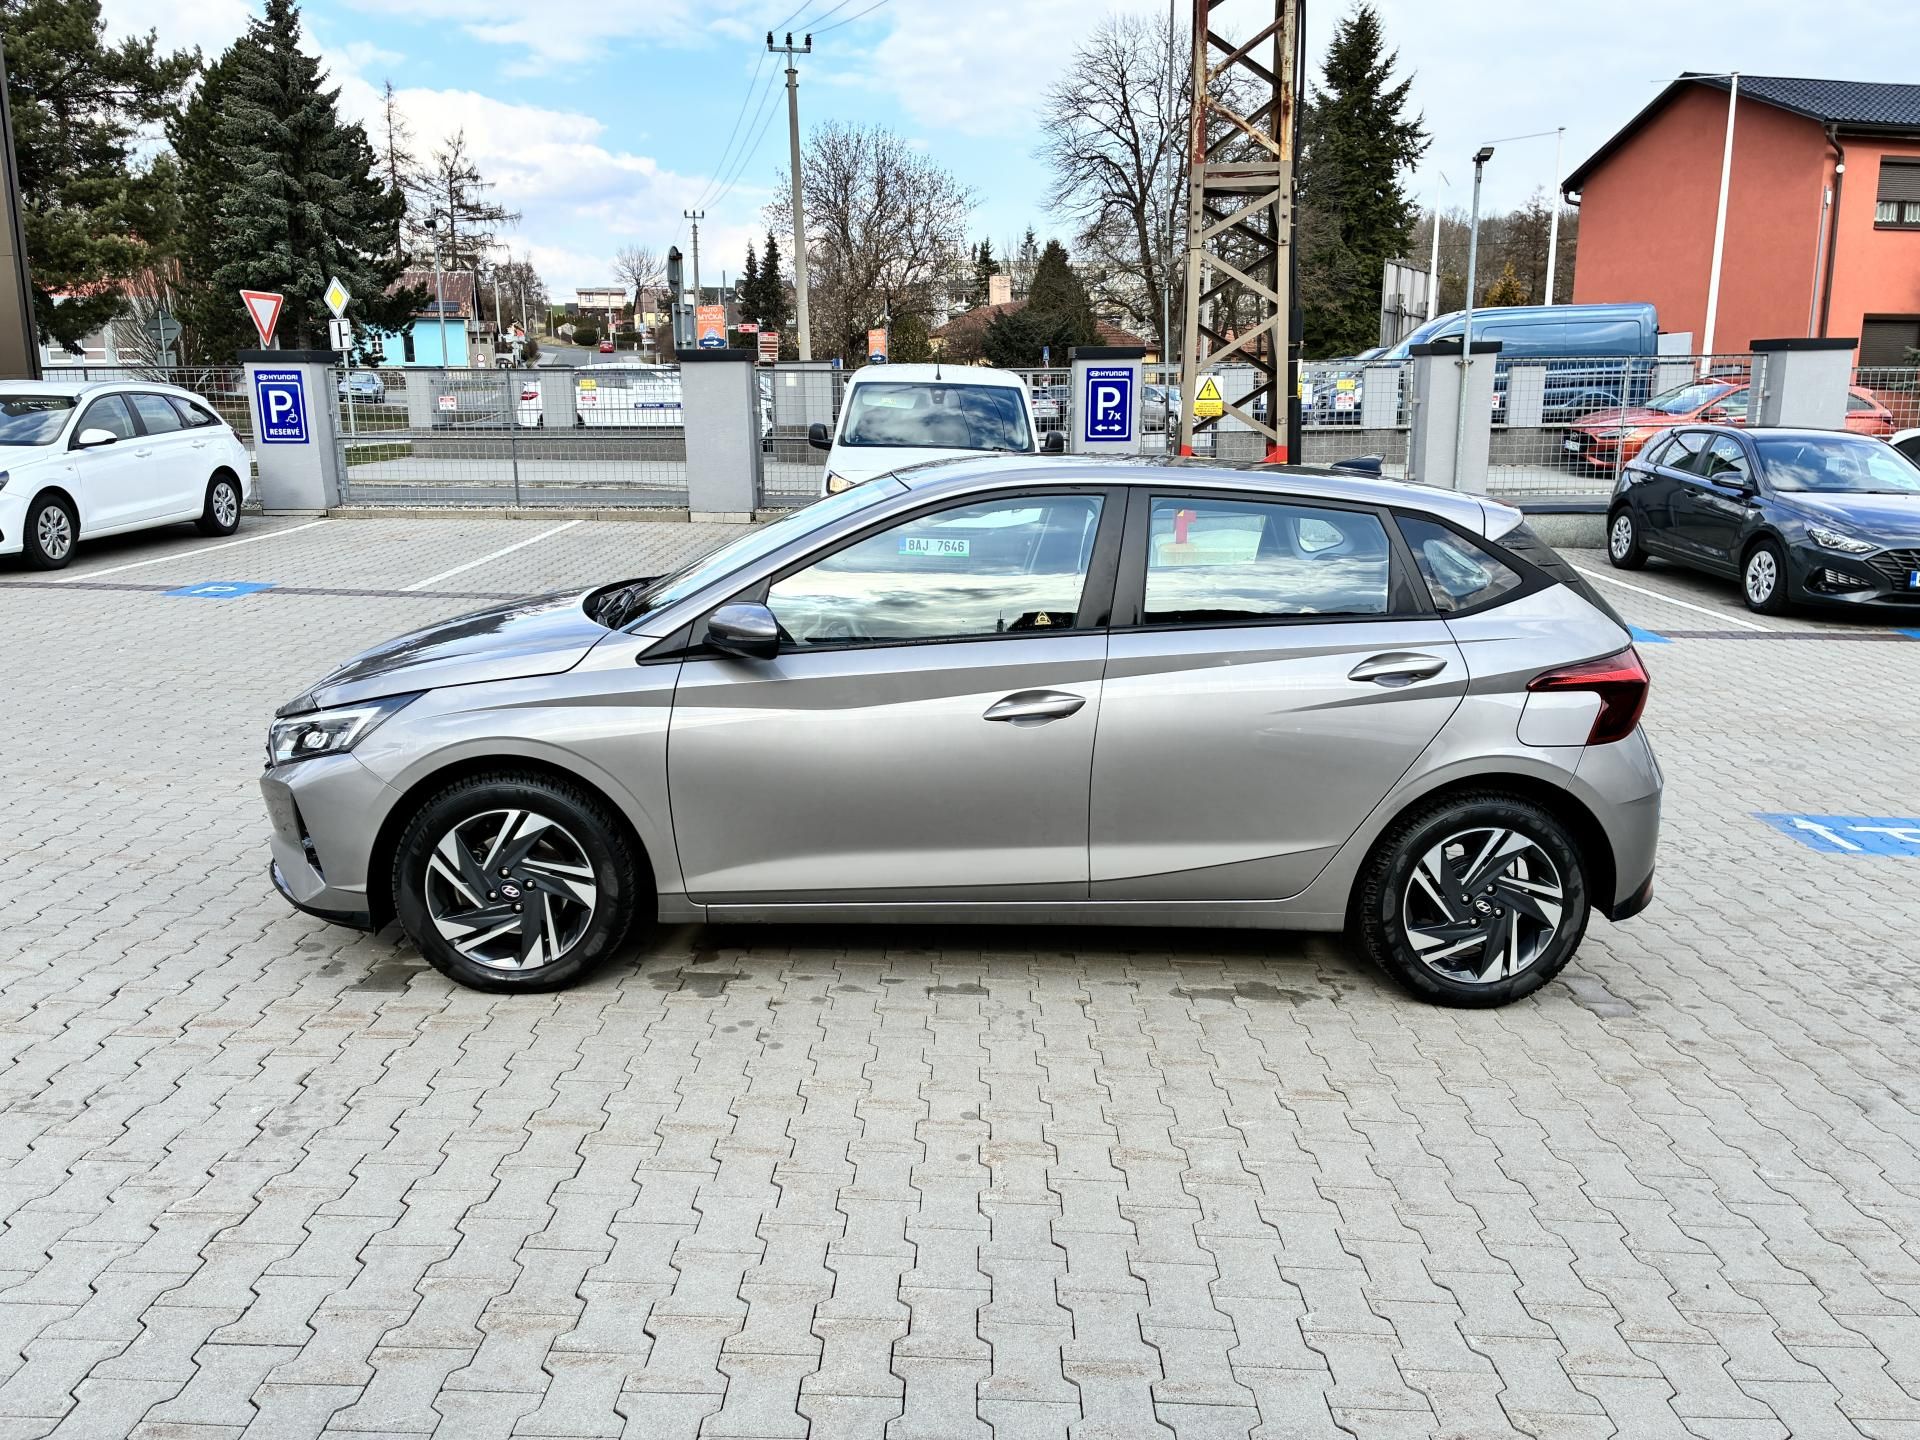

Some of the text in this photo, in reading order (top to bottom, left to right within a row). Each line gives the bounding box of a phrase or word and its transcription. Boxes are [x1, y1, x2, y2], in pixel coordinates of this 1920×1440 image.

[268, 390, 293, 424] P
[1097, 386, 1121, 420] P
[1107, 410, 1122, 420] 7x
[269, 426, 301, 436] RESERVÉ
[908, 539, 965, 552] 8AJ 7646
